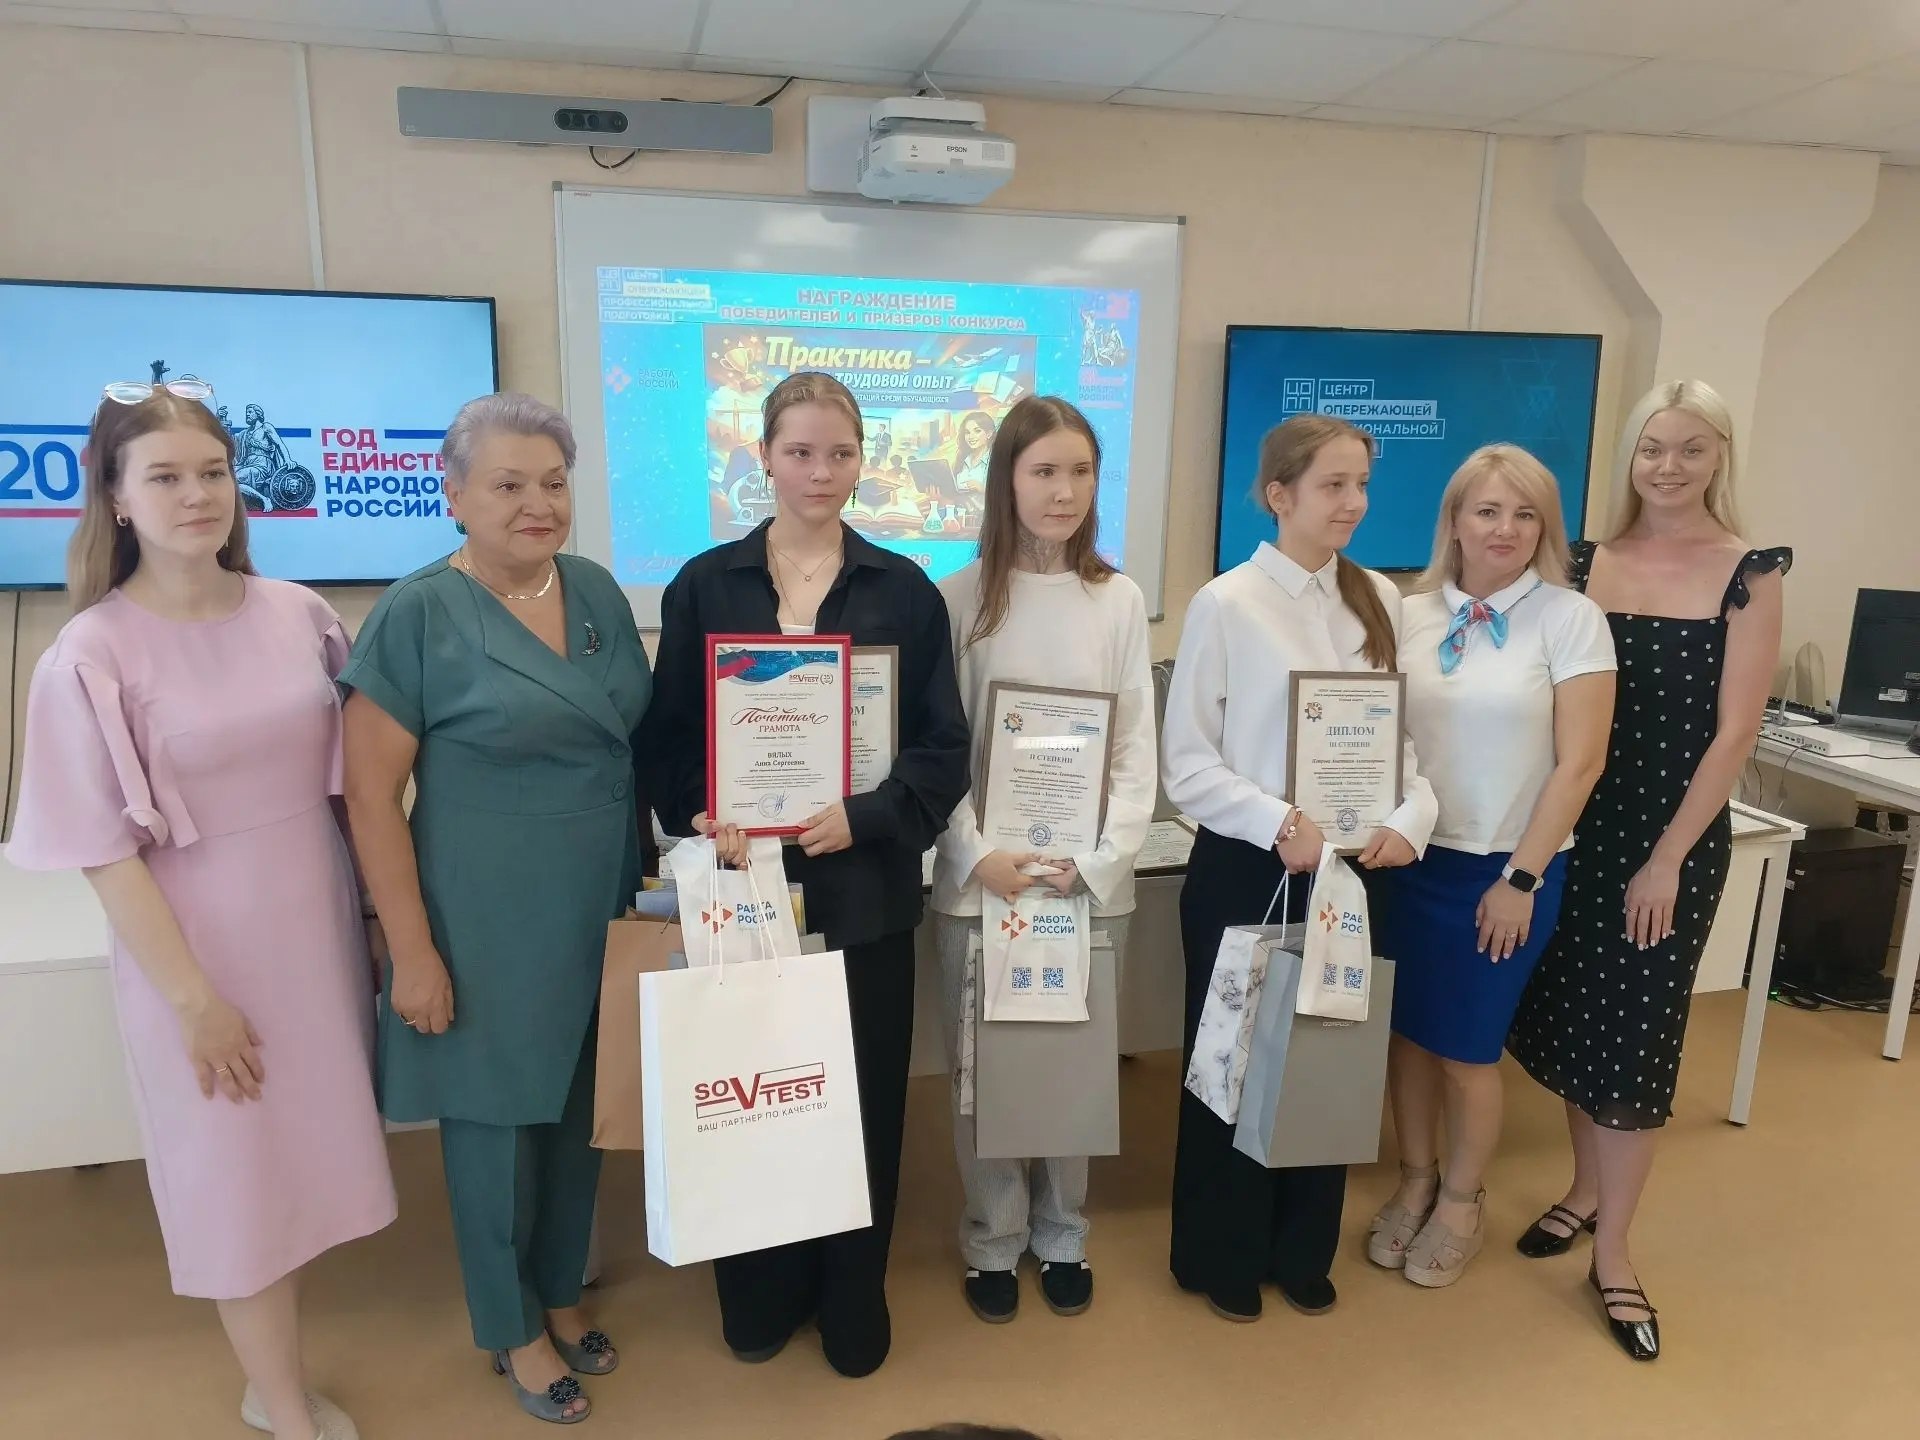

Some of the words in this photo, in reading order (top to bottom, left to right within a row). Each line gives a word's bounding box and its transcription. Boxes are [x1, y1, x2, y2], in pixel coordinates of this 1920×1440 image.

[626, 271, 659, 280] ЦЕНТР
[603, 297, 713, 309] ПРОФЕССИОНАЛЬНОЙ
[798, 289, 957, 310] НАГРАЖДЕНИЕ
[603, 310, 671, 321] ПОДГОТОВКИ
[721, 306, 841, 323] ПОБЕДИТЕЛЕЙ
[846, 311, 857, 324] И
[862, 311, 942, 327] ПРИЗЕРОВ
[948, 316, 1027, 331] КОНКУРСА
[765, 336, 912, 372] Практика
[639, 369, 675, 378] РАБОТА
[639, 379, 679, 389] РОССИИ
[912, 375, 954, 390] ОПЫТ
[1324, 384, 1368, 397] ЦЕНТР
[855, 394, 879, 403] НТАЦИЙ
[881, 394, 902, 403] СРЕДИ
[903, 395, 949, 404] ОБУЧАЮЩИХСЯ
[1323, 403, 1432, 418] ОПЕРЕЖАЮЩЕЙ
[321, 428, 378, 450] ГОД
[322, 452, 446, 474] ЕДИНСТВ
[0, 441, 88, 501] 20
[324, 476, 444, 497] НАРОДО
[326, 499, 441, 517] РОССИИ
[759, 724, 801, 733] ГРАМОТА
[1325, 726, 1375, 737] ДИПЛОМ
[767, 751, 792, 759] ВЯЛЫХ
[1036, 754, 1073, 764] СТЕПЕНИ
[772, 759, 805, 768] Сергеевна
[1032, 915, 1073, 924] РАБОТА
[1032, 925, 1075, 934] РОССИИ
[694, 1073, 826, 1110] SOVTEST
[697, 1122, 718, 1133] ВАШ
[721, 1113, 763, 1128] ПАРТНЕР
[765, 1110, 779, 1119] ПО
[782, 1101, 829, 1117] КАЧЕСТВУ
